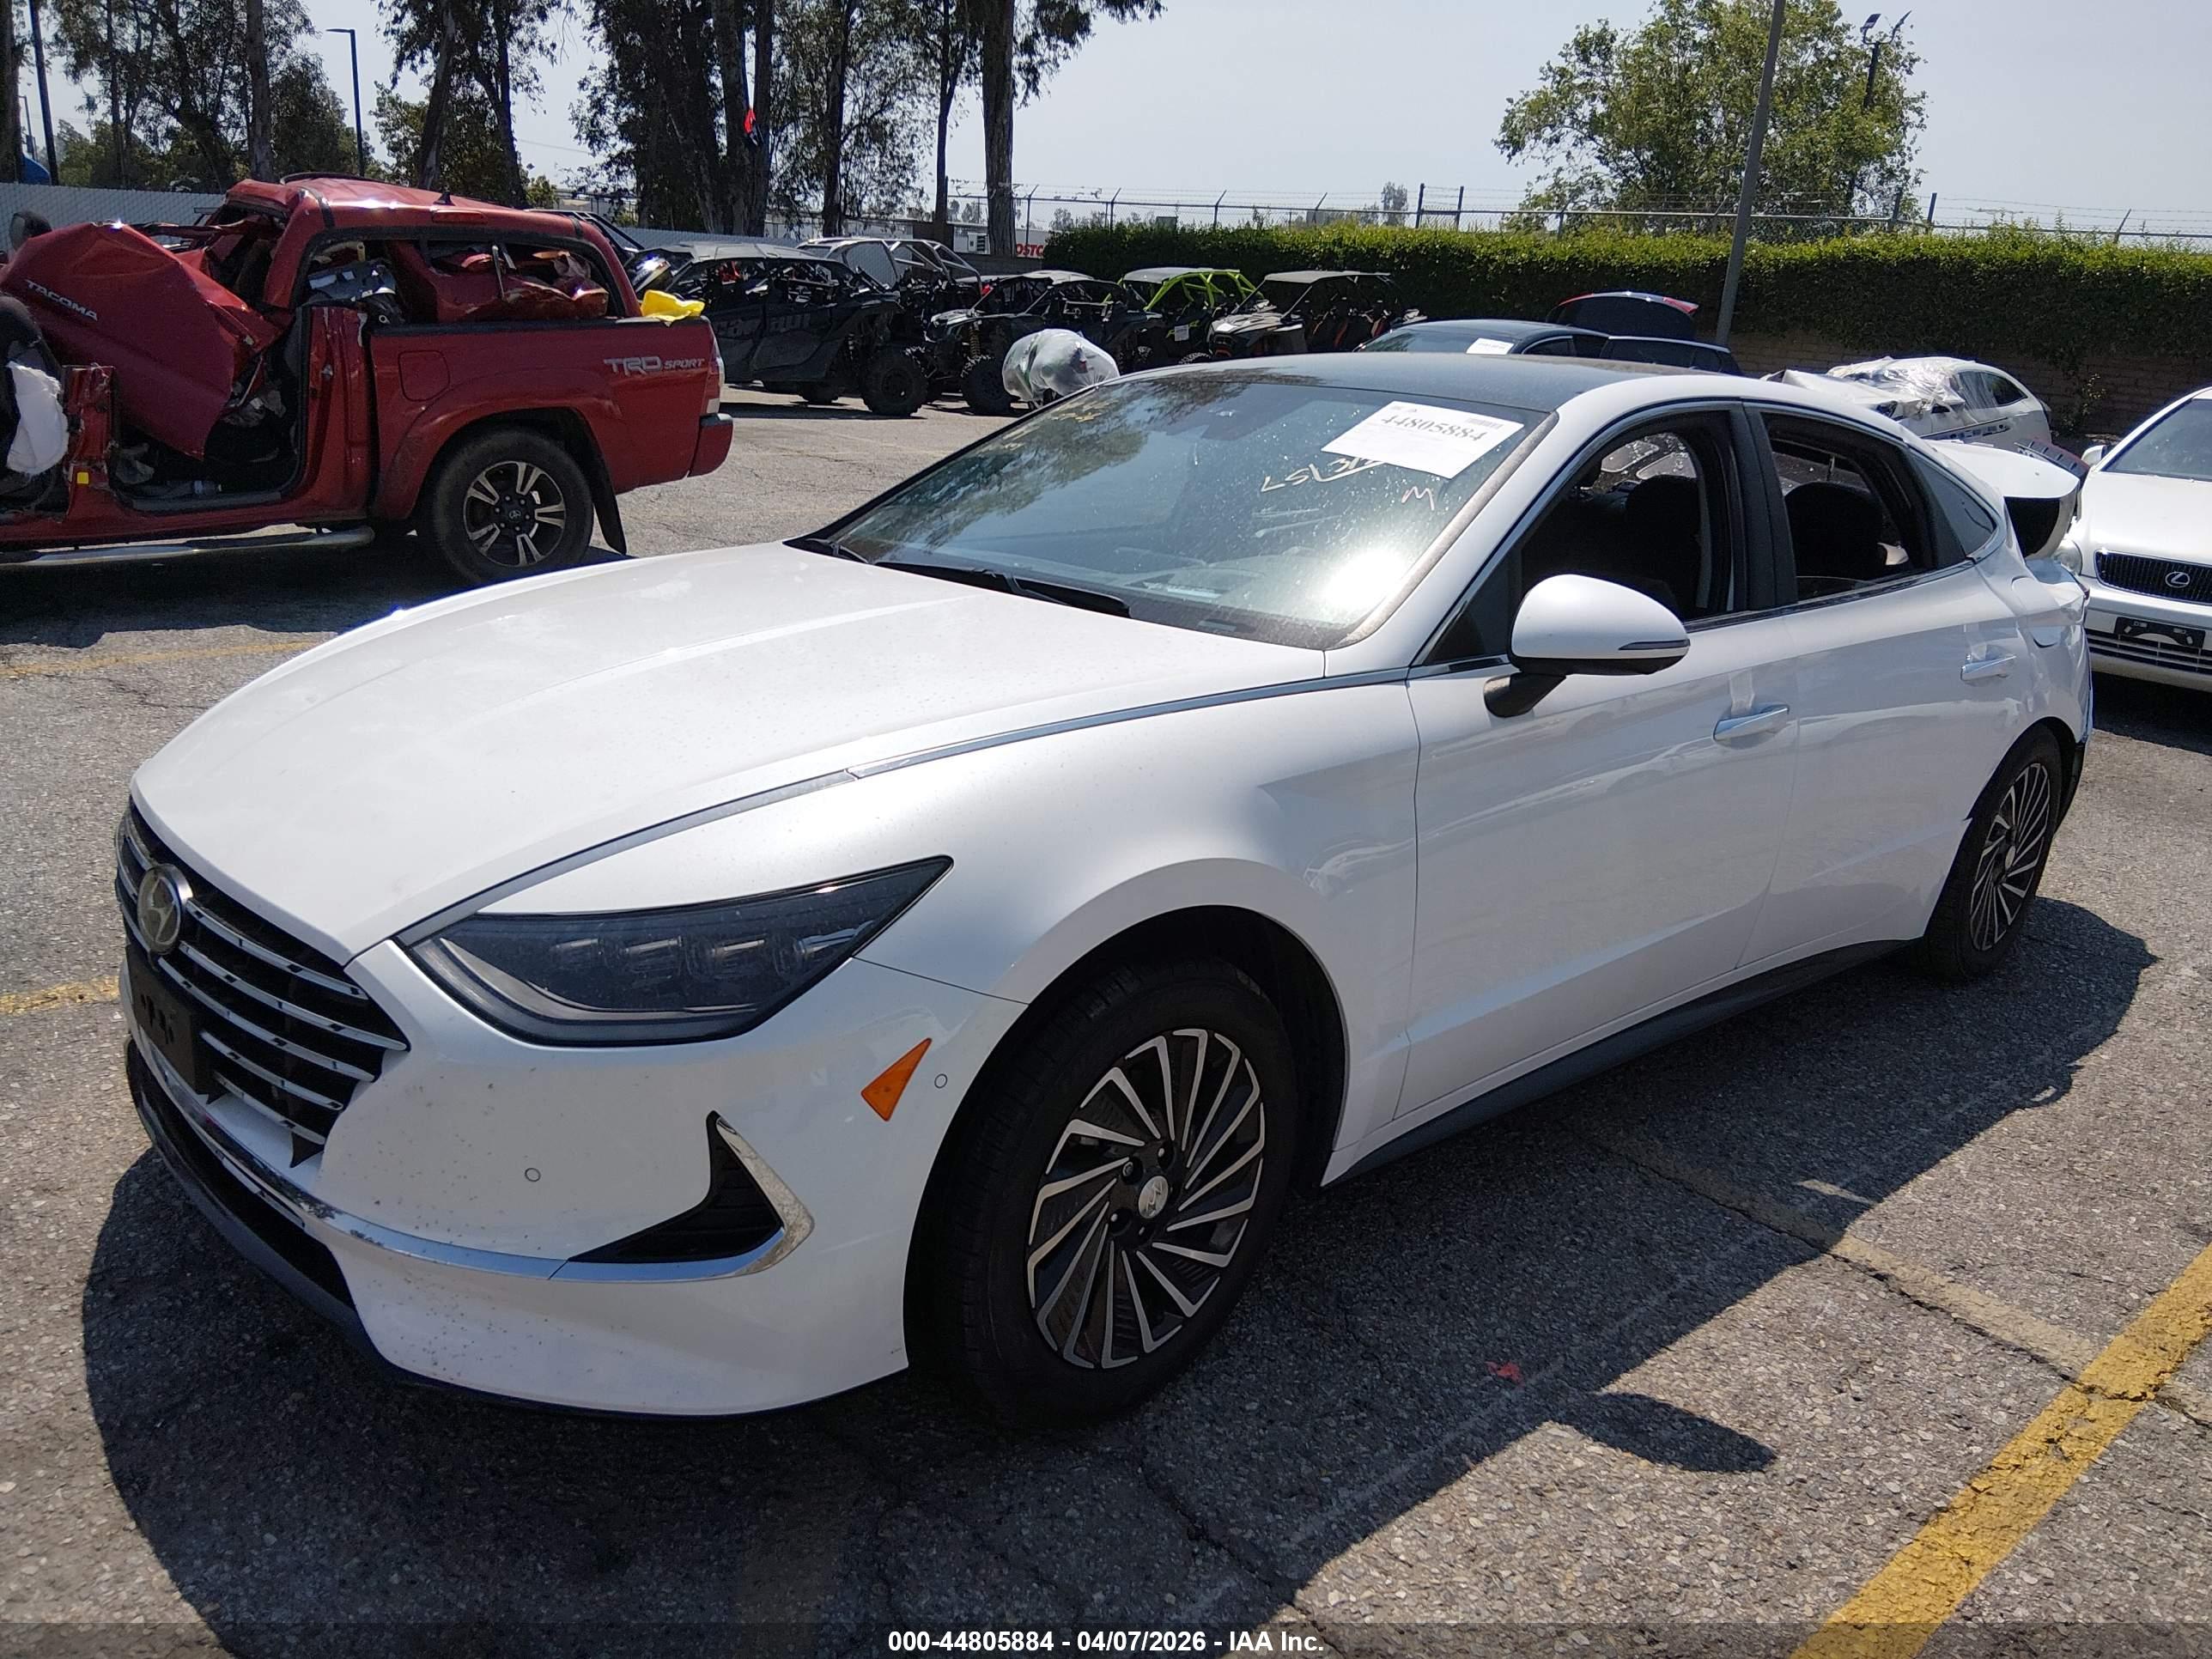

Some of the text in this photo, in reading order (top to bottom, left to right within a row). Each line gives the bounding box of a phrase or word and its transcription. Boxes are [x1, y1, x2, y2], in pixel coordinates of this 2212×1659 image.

[1016, 243, 1045, 257] OSTC
[25, 278, 97, 321] TACOMA
[604, 356, 705, 377] TRD SPORT
[1381, 415, 1488, 441] 44805884
